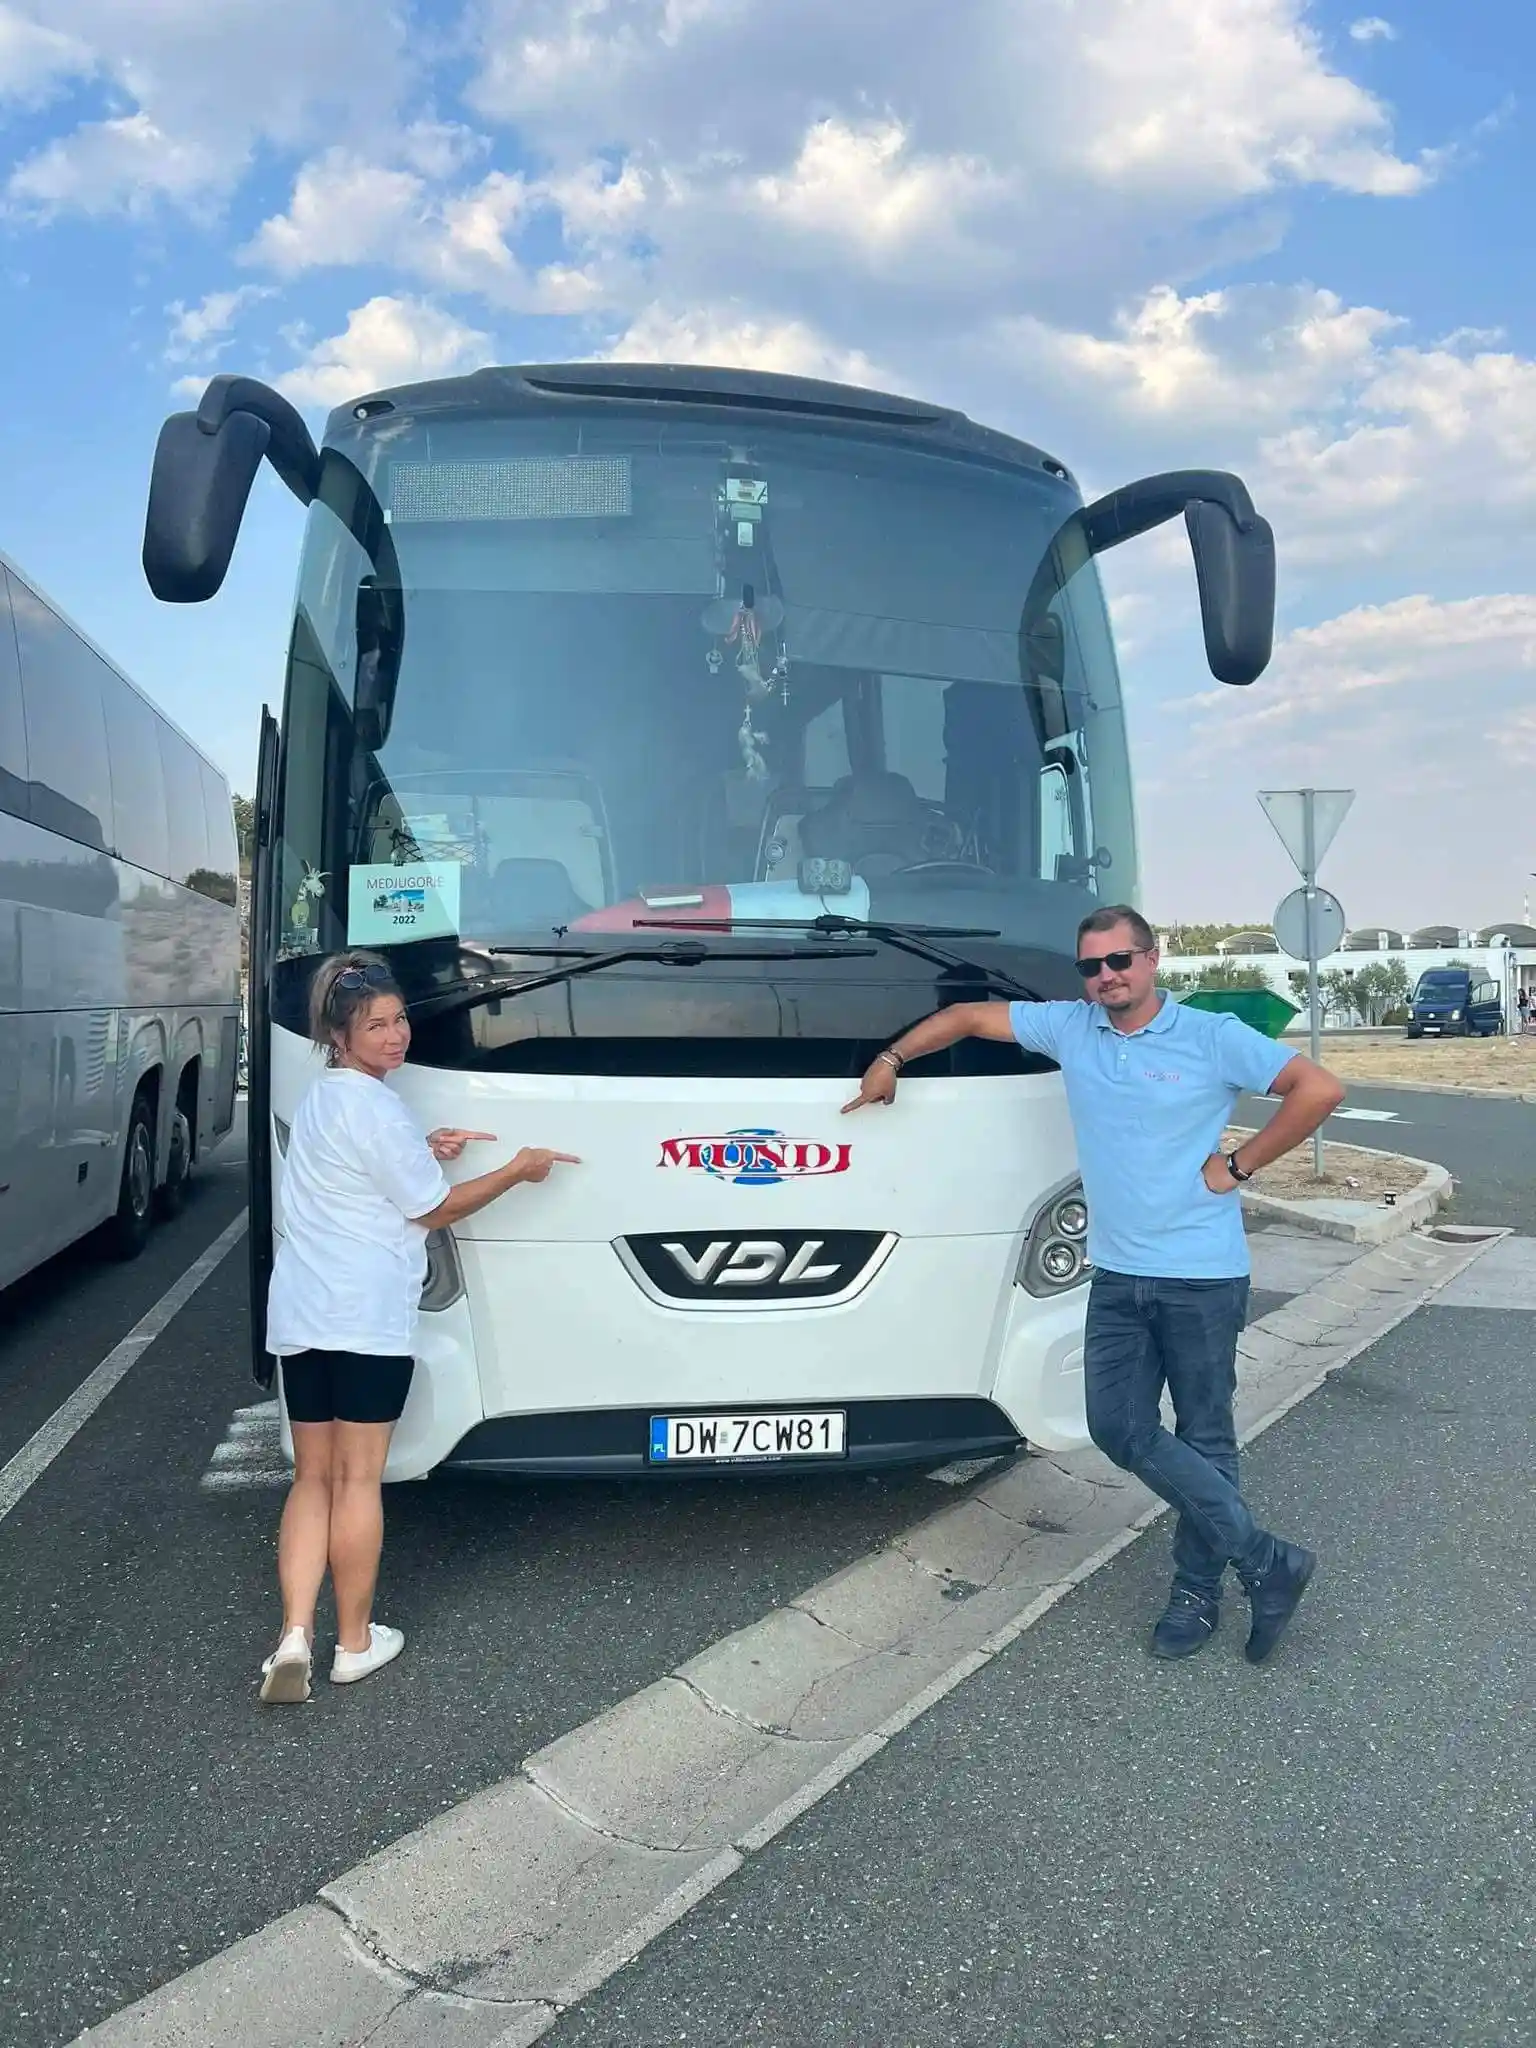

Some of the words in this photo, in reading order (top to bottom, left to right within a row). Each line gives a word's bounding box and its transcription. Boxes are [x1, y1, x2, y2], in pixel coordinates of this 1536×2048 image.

[392, 915, 416, 925] 2022
[660, 1240, 843, 1286] VDL
[675, 1422, 718, 1455] DW
[732, 1418, 830, 1453] 7CW81
